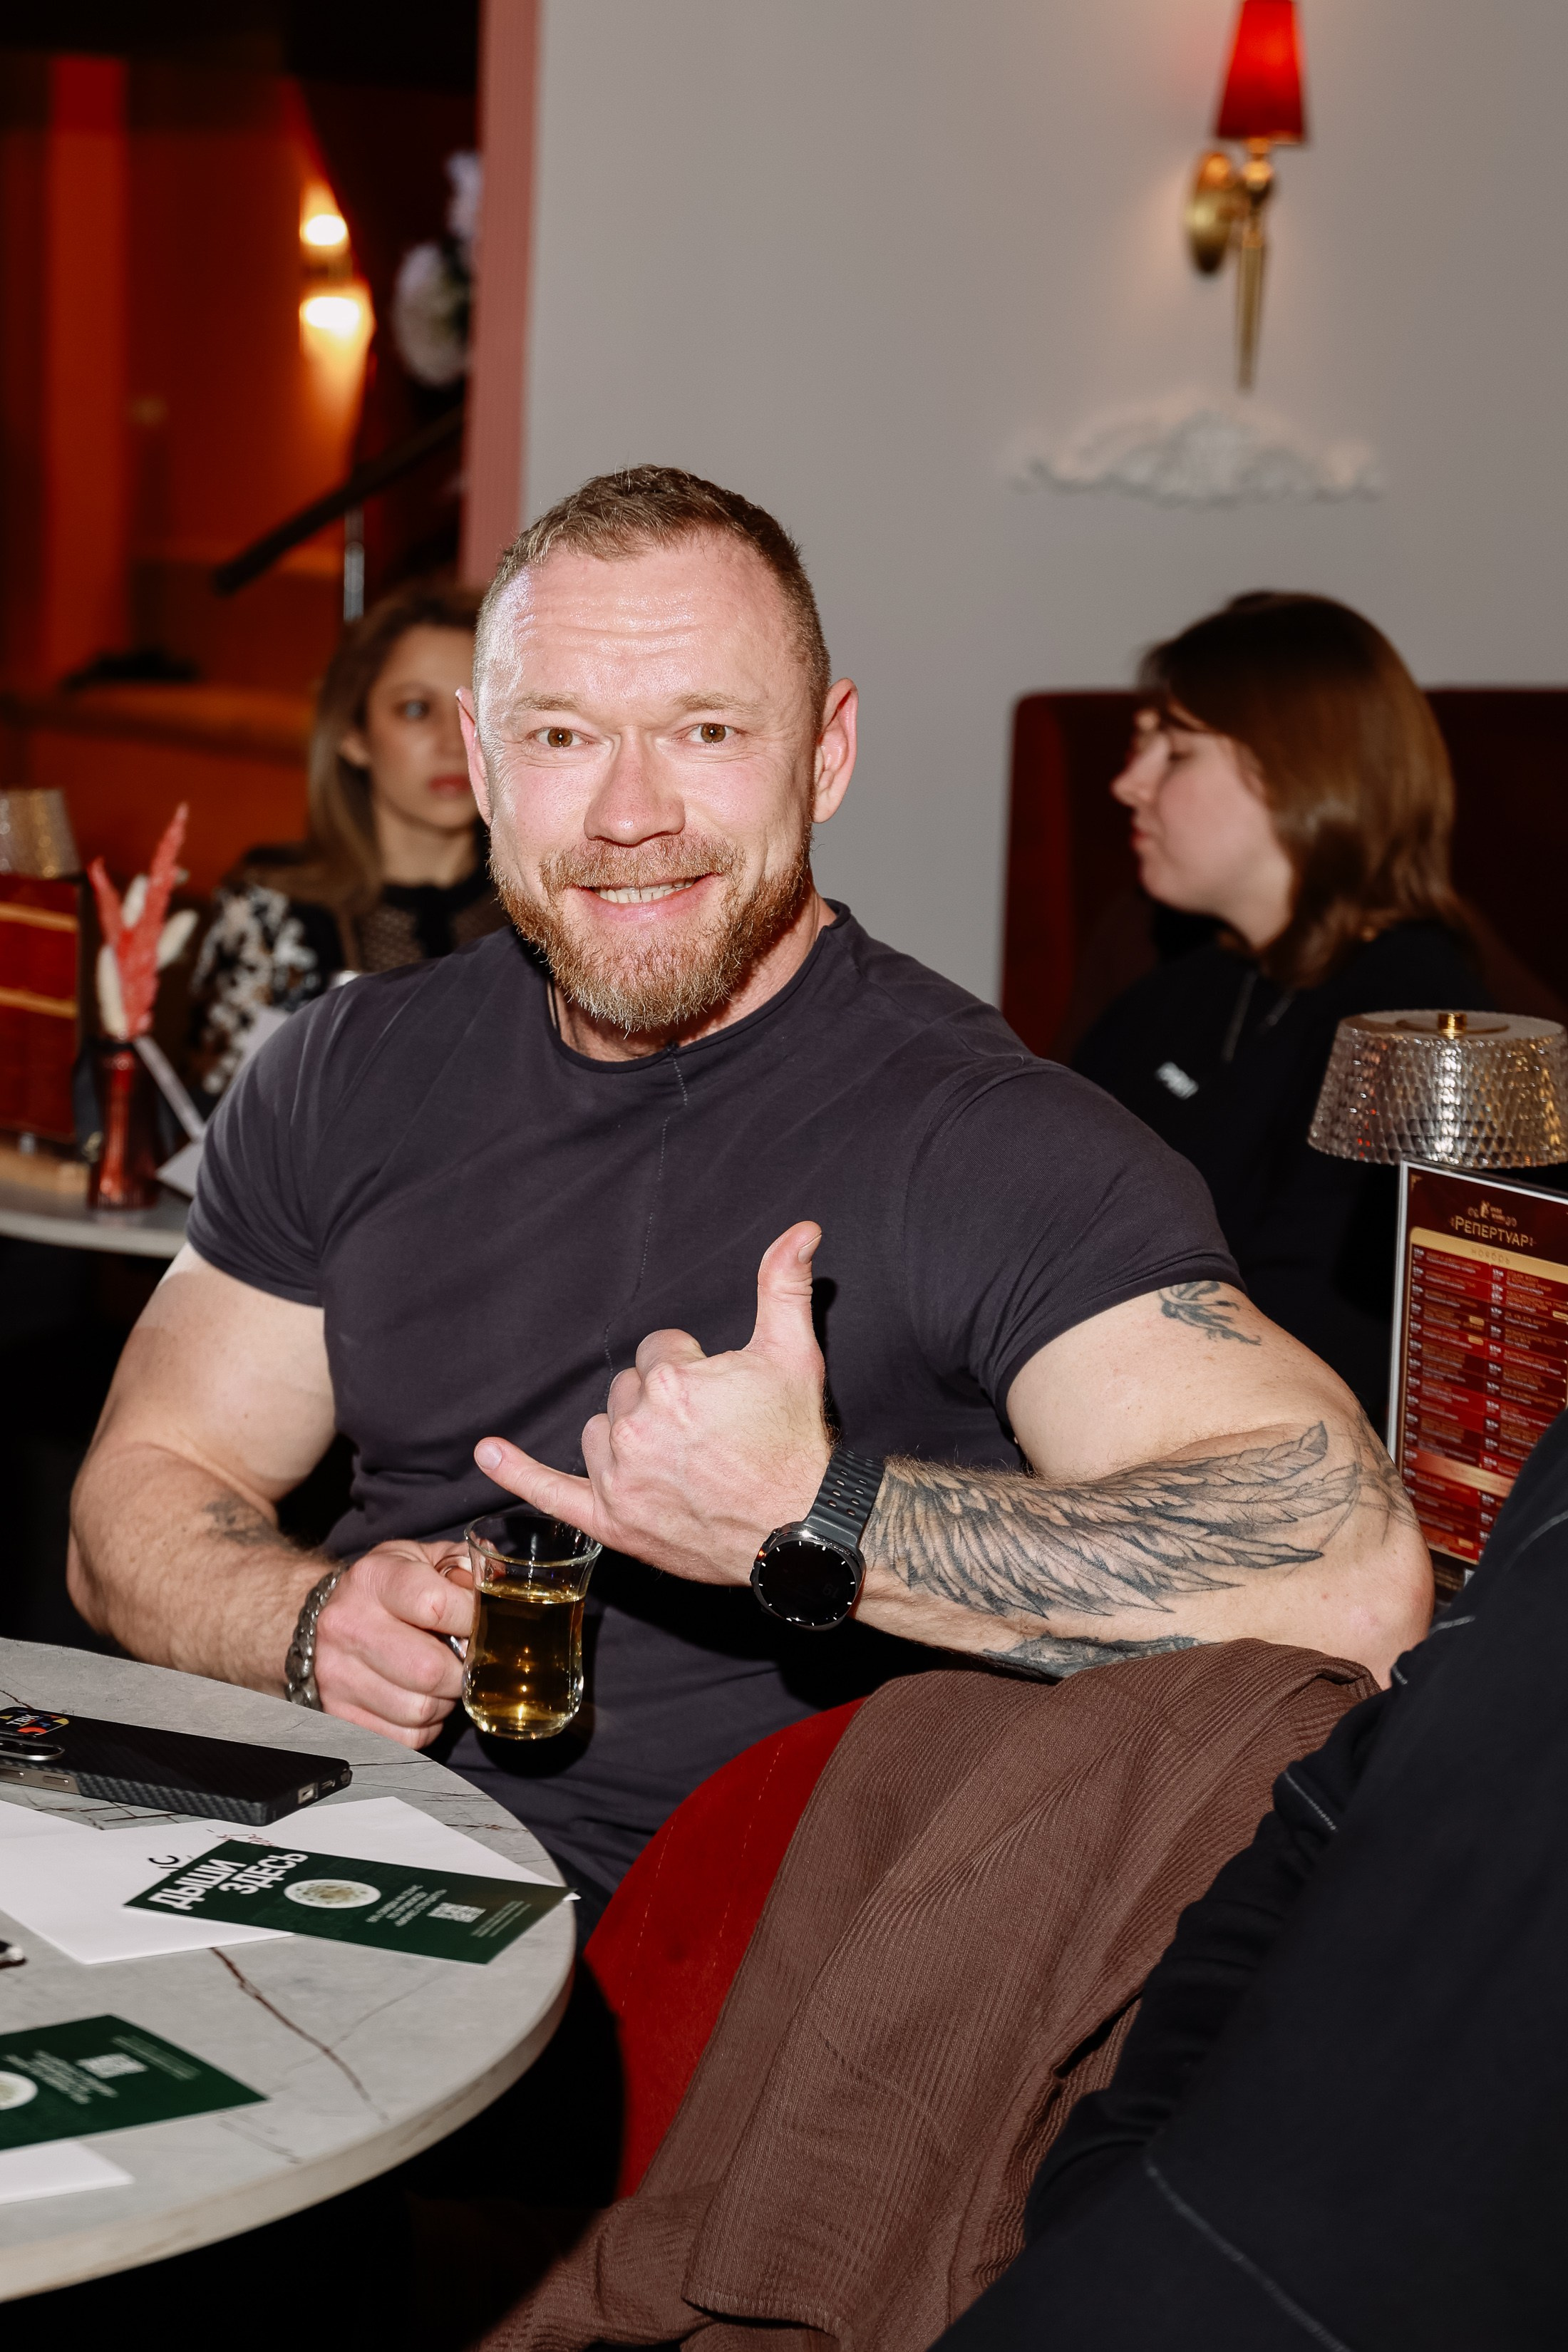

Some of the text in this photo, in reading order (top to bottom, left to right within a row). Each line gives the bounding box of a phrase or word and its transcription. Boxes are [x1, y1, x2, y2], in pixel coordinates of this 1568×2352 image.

[1454, 1214, 1530, 1247] РЕПЕРТУАР
[147, 1858, 248, 1911] ДЫШИ
[217, 1852, 309, 1895] ЗДЕСЬ
